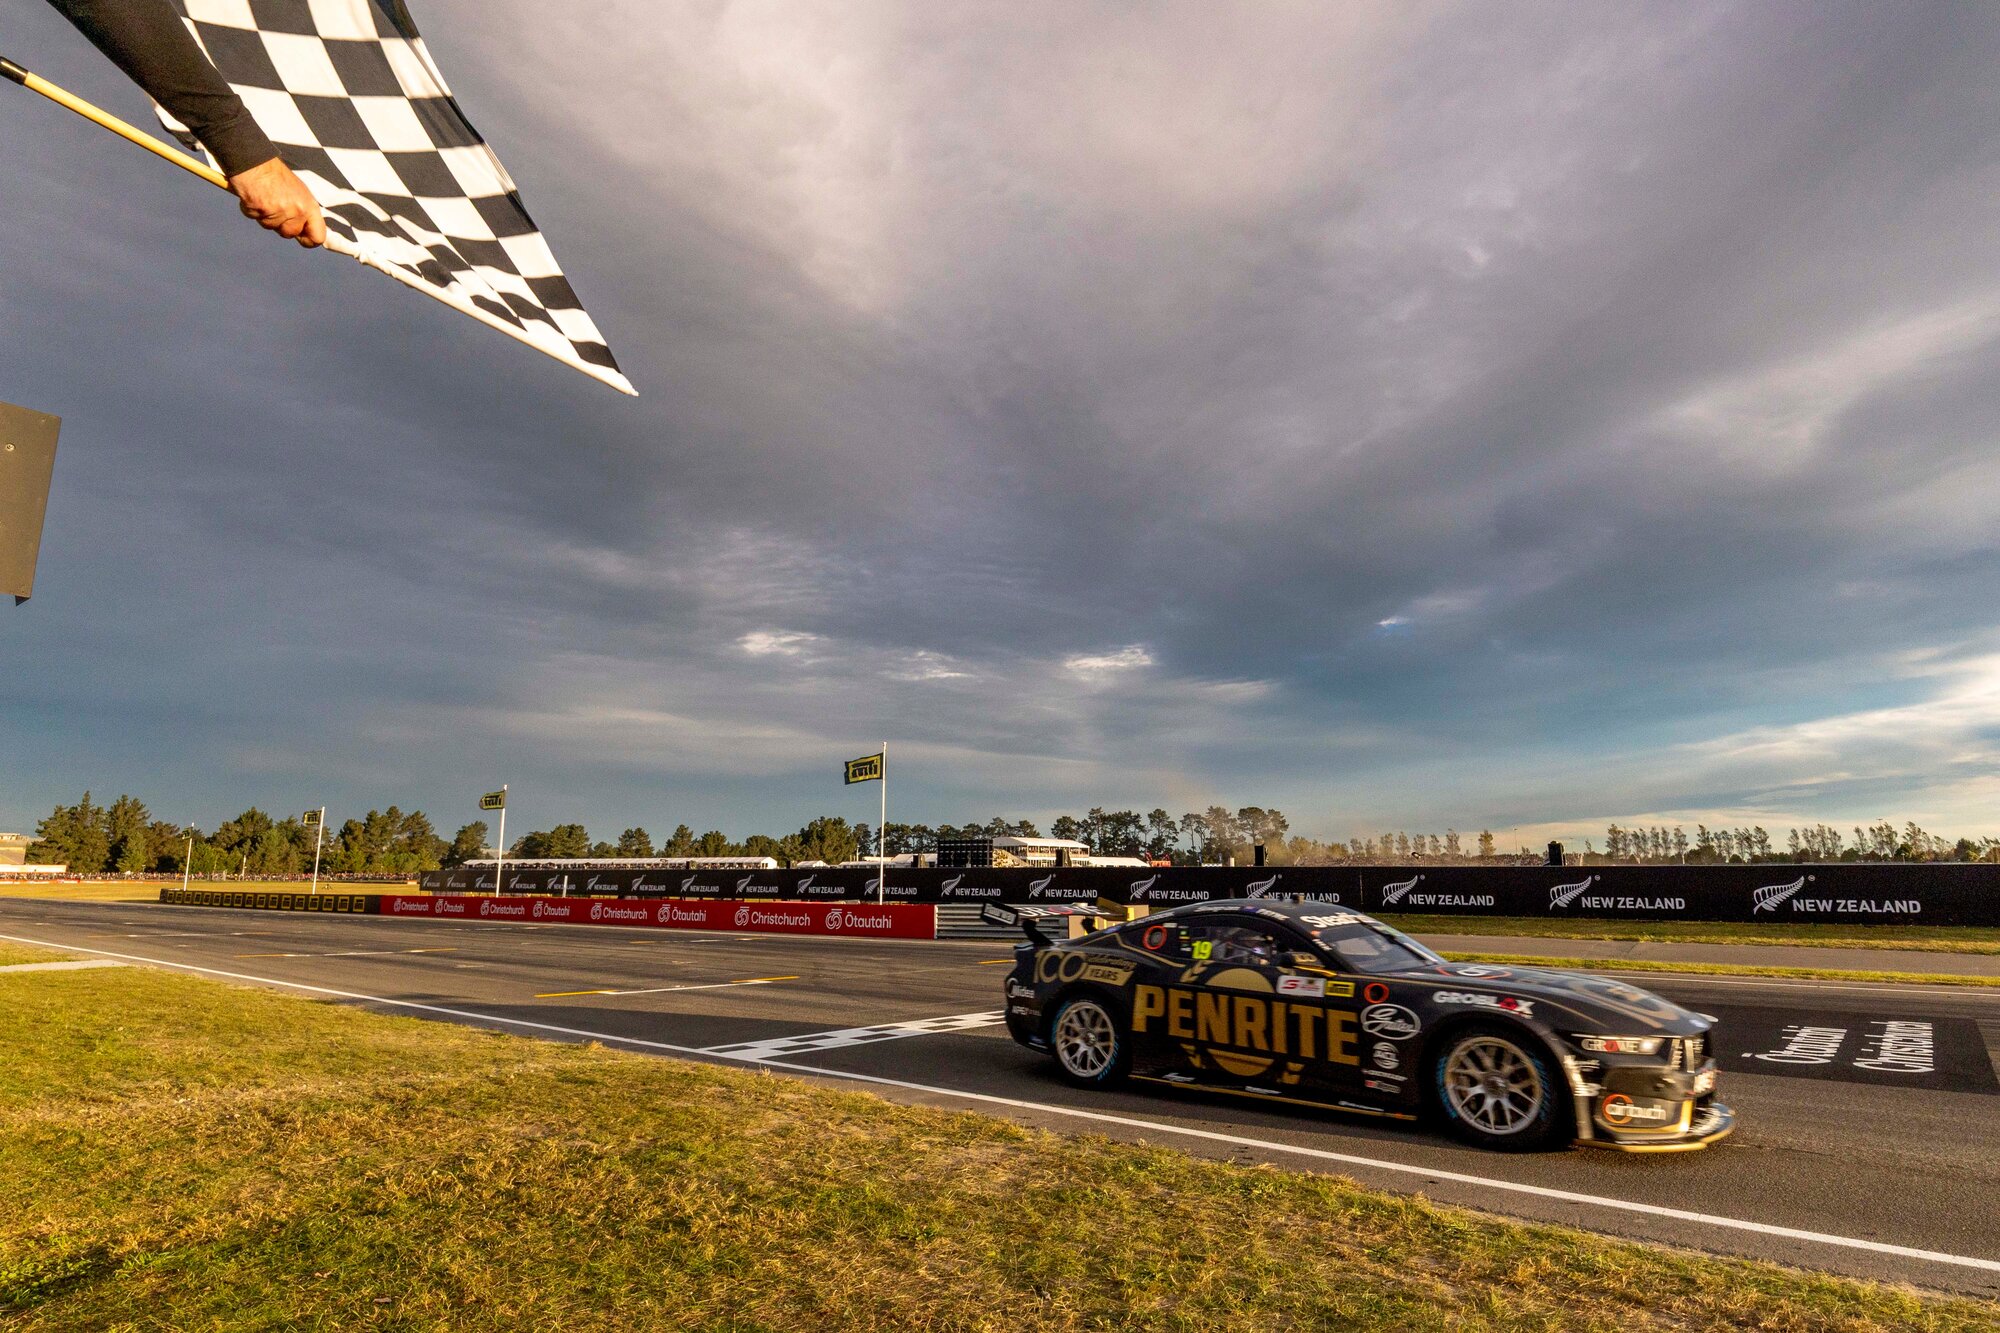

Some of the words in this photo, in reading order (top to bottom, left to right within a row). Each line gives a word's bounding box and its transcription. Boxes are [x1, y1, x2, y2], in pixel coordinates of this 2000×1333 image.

[757, 886, 779, 894] ZEALAND
[808, 886, 820, 894] NEW
[821, 886, 845, 894] ZEALAND
[890, 887, 918, 895] ZEALAND
[955, 888, 970, 896] NEW
[971, 888, 1001, 897] ZEALAND
[1045, 889, 1062, 898] NEW
[1063, 889, 1098, 898] ZEALAND
[1149, 890, 1168, 900] NEW
[1169, 890, 1210, 900] ZEALAND
[1292, 892, 1340, 903] ALAND
[1408, 894, 1436, 905] NEW
[1437, 895, 1495, 906] ZEALAND
[1581, 897, 1614, 908] NEW
[1616, 897, 1686, 909] ZEALAND
[490, 903, 525, 915] Christchurch
[543, 903, 571, 916] Ōtautahi
[1791, 899, 1833, 912] NEW
[1835, 899, 1922, 913] ZEALAND
[603, 906, 648, 920] Christchurch
[672, 906, 706, 922] Ōtautahi
[751, 911, 811, 926] Christchurch
[845, 912, 892, 929] Ōtautahi
[1191, 940, 1213, 960] 19
[1090, 968, 1118, 981] YEARS
[1131, 984, 1361, 1067] PENRITE
[1741, 1025, 1848, 1064] Ōtautahi
[1852, 1020, 1935, 1073] Christchurch
